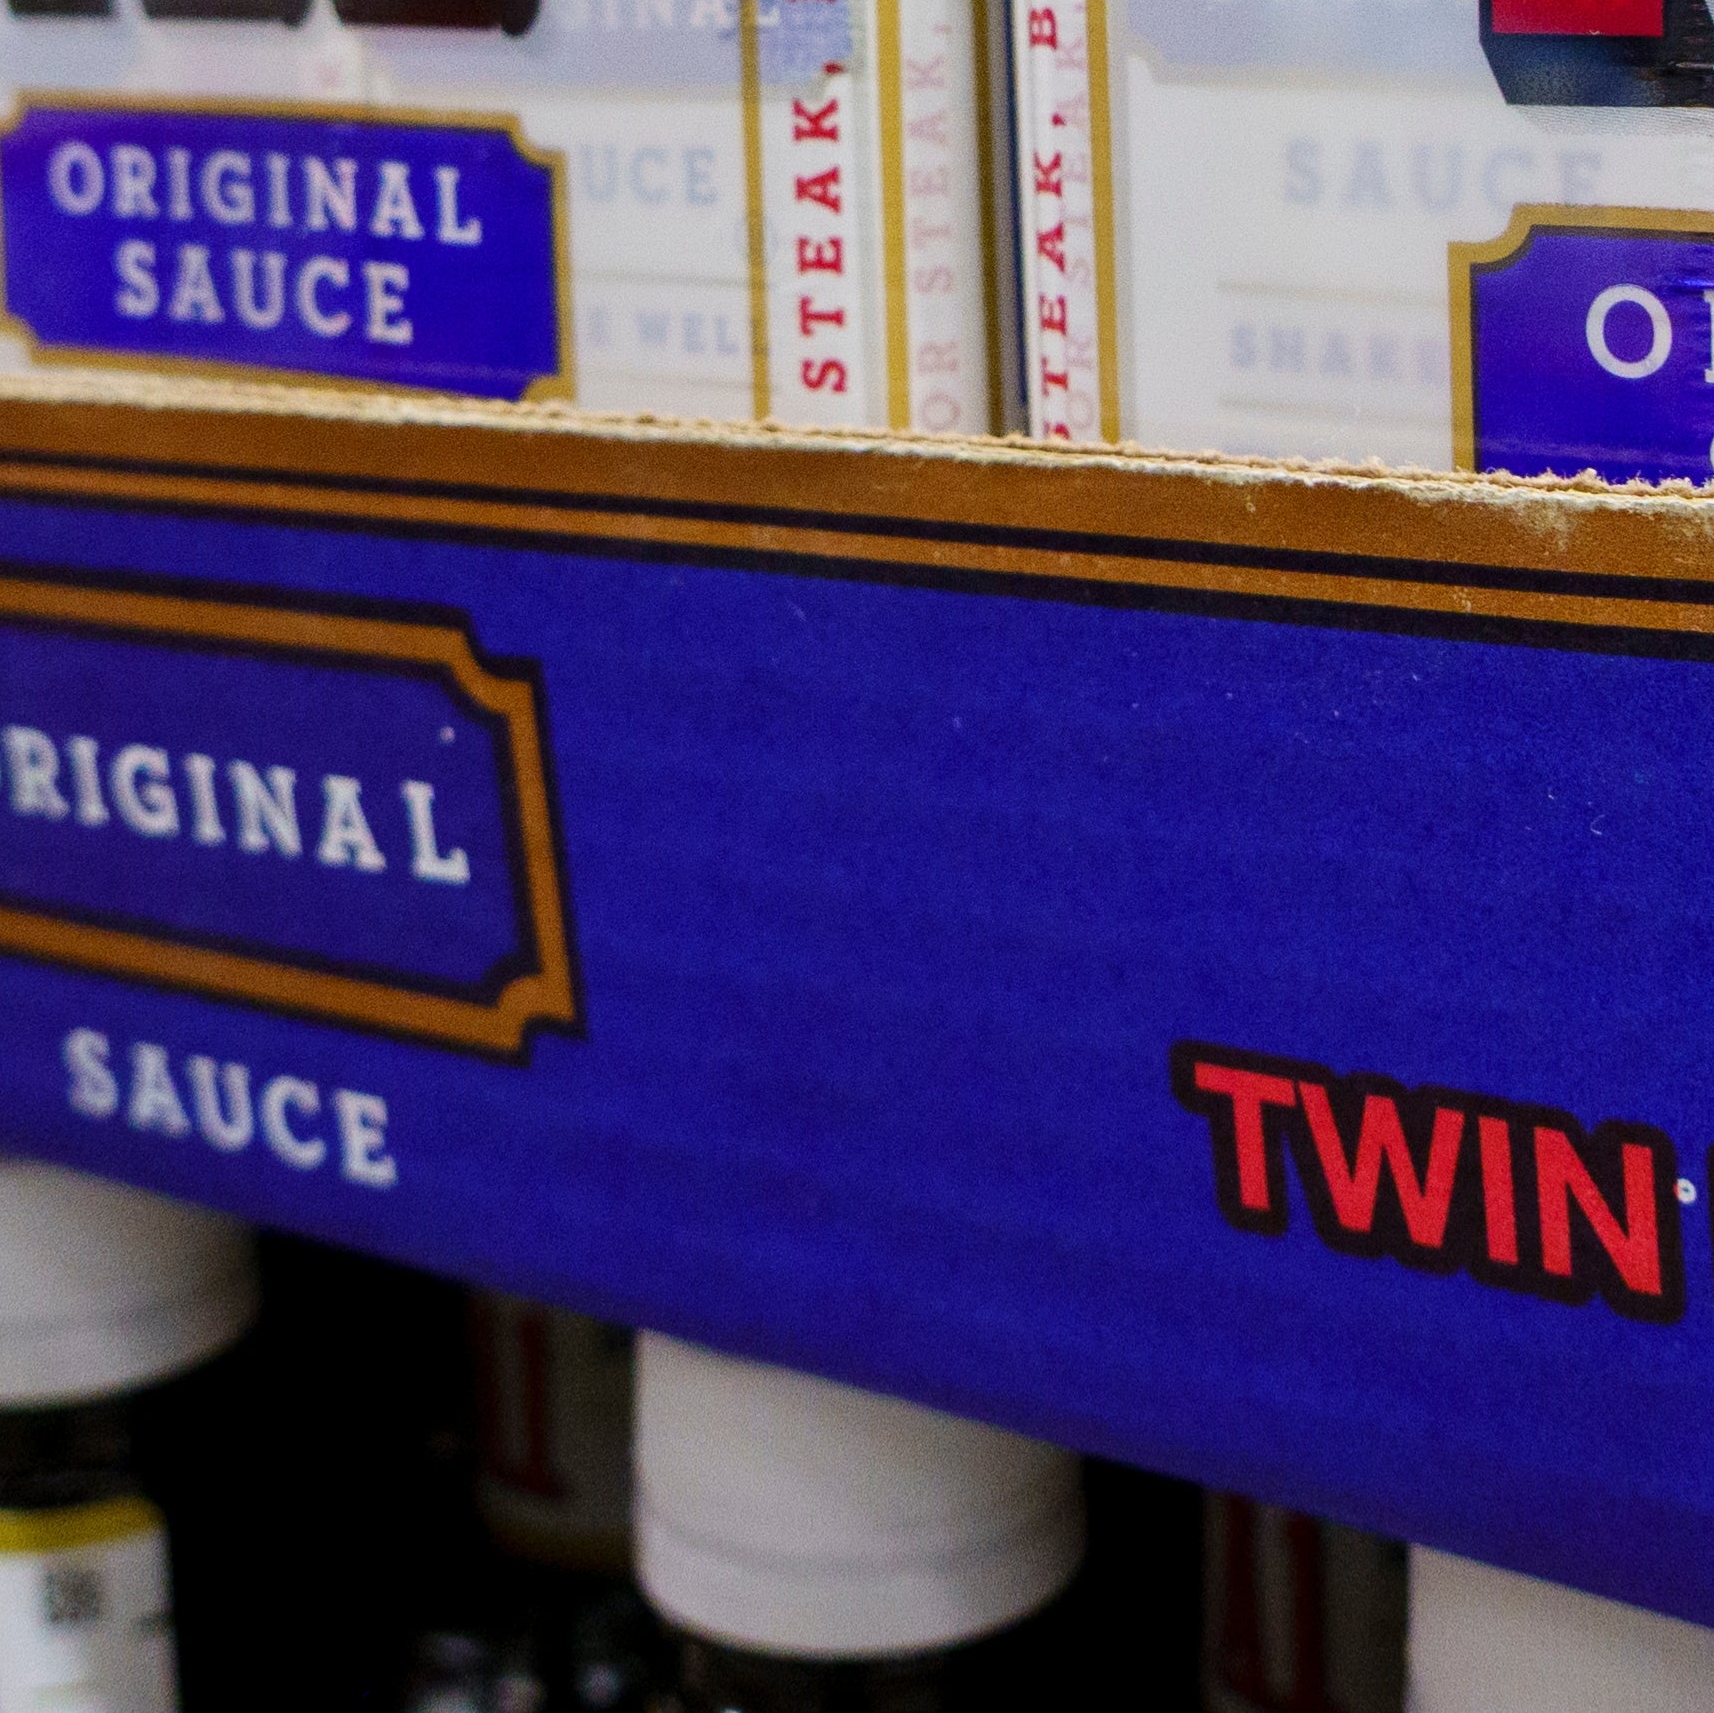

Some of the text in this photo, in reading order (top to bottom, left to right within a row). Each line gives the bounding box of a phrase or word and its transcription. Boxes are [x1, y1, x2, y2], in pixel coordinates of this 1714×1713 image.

[47, 140, 484, 246] ORIGINAL
[791, 62, 849, 395] STEAK,
[115, 240, 415, 346] SAUCE
[915, 339, 962, 435] OR
[62, 1027, 399, 1190] SAUCE
[1191, 1059, 1667, 1299] TWIN
